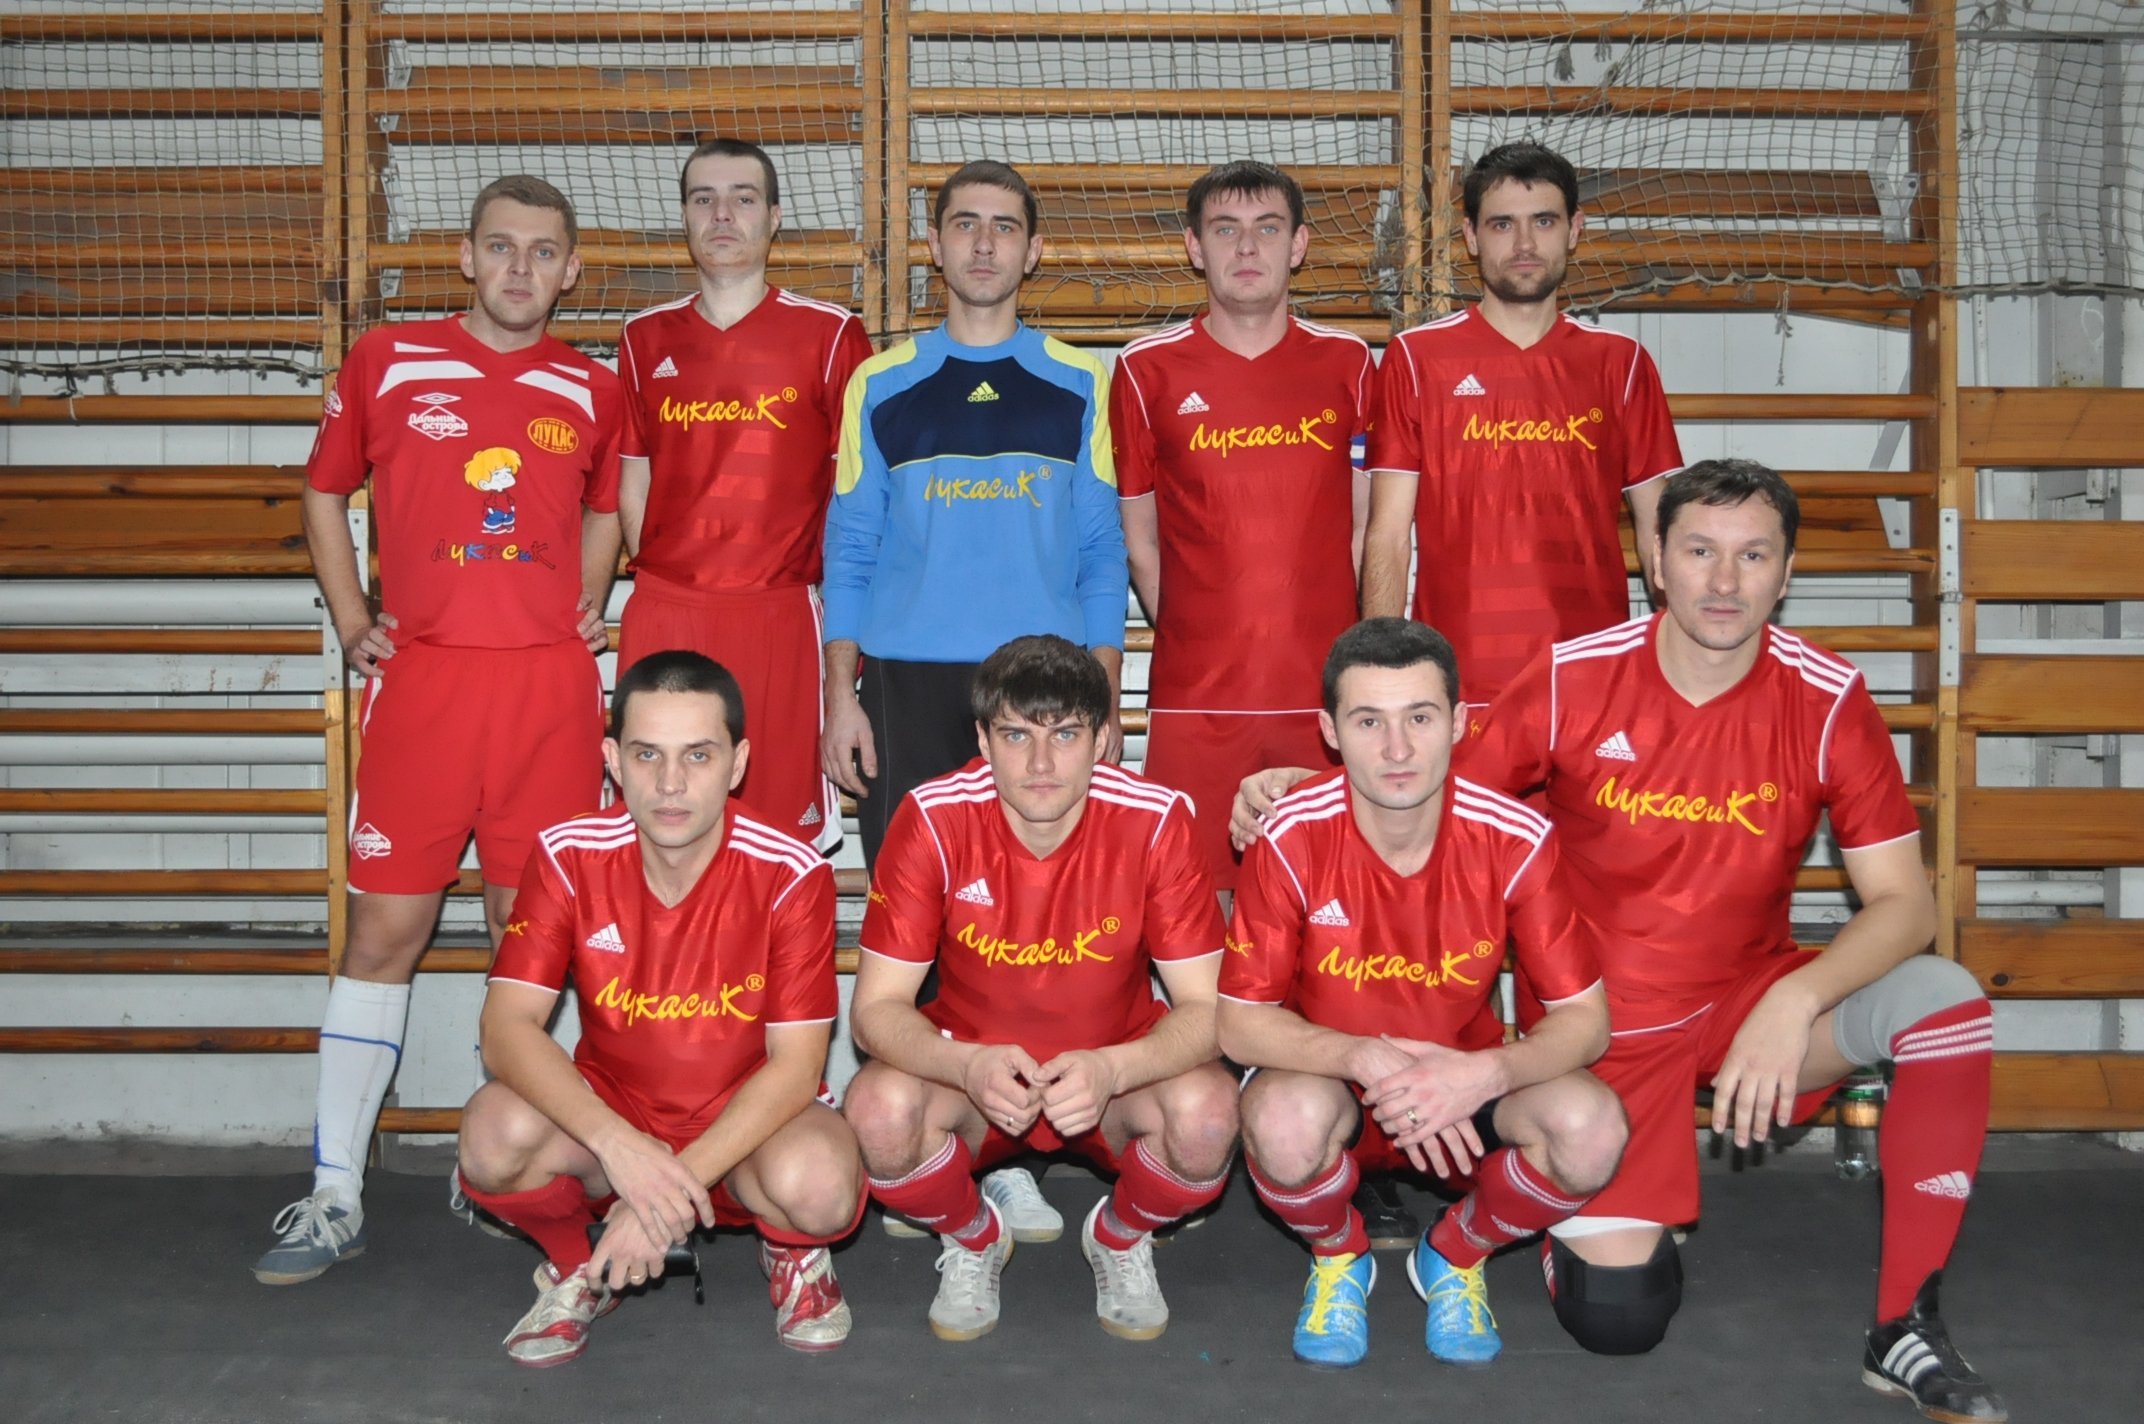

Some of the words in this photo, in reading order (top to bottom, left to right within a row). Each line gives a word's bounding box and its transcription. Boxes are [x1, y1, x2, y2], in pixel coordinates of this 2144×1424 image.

[967, 392, 1000, 402] adidas
[1453, 386, 1486, 397] adidas
[1177, 403, 1210, 415] adidas
[533, 422, 575, 448] ЛУКАС
[1595, 747, 1636, 762] adidas
[955, 890, 994, 907] adidas
[1309, 914, 1350, 927] adidas
[586, 936, 626, 954] adidas
[1913, 1182, 1970, 1199] adida
